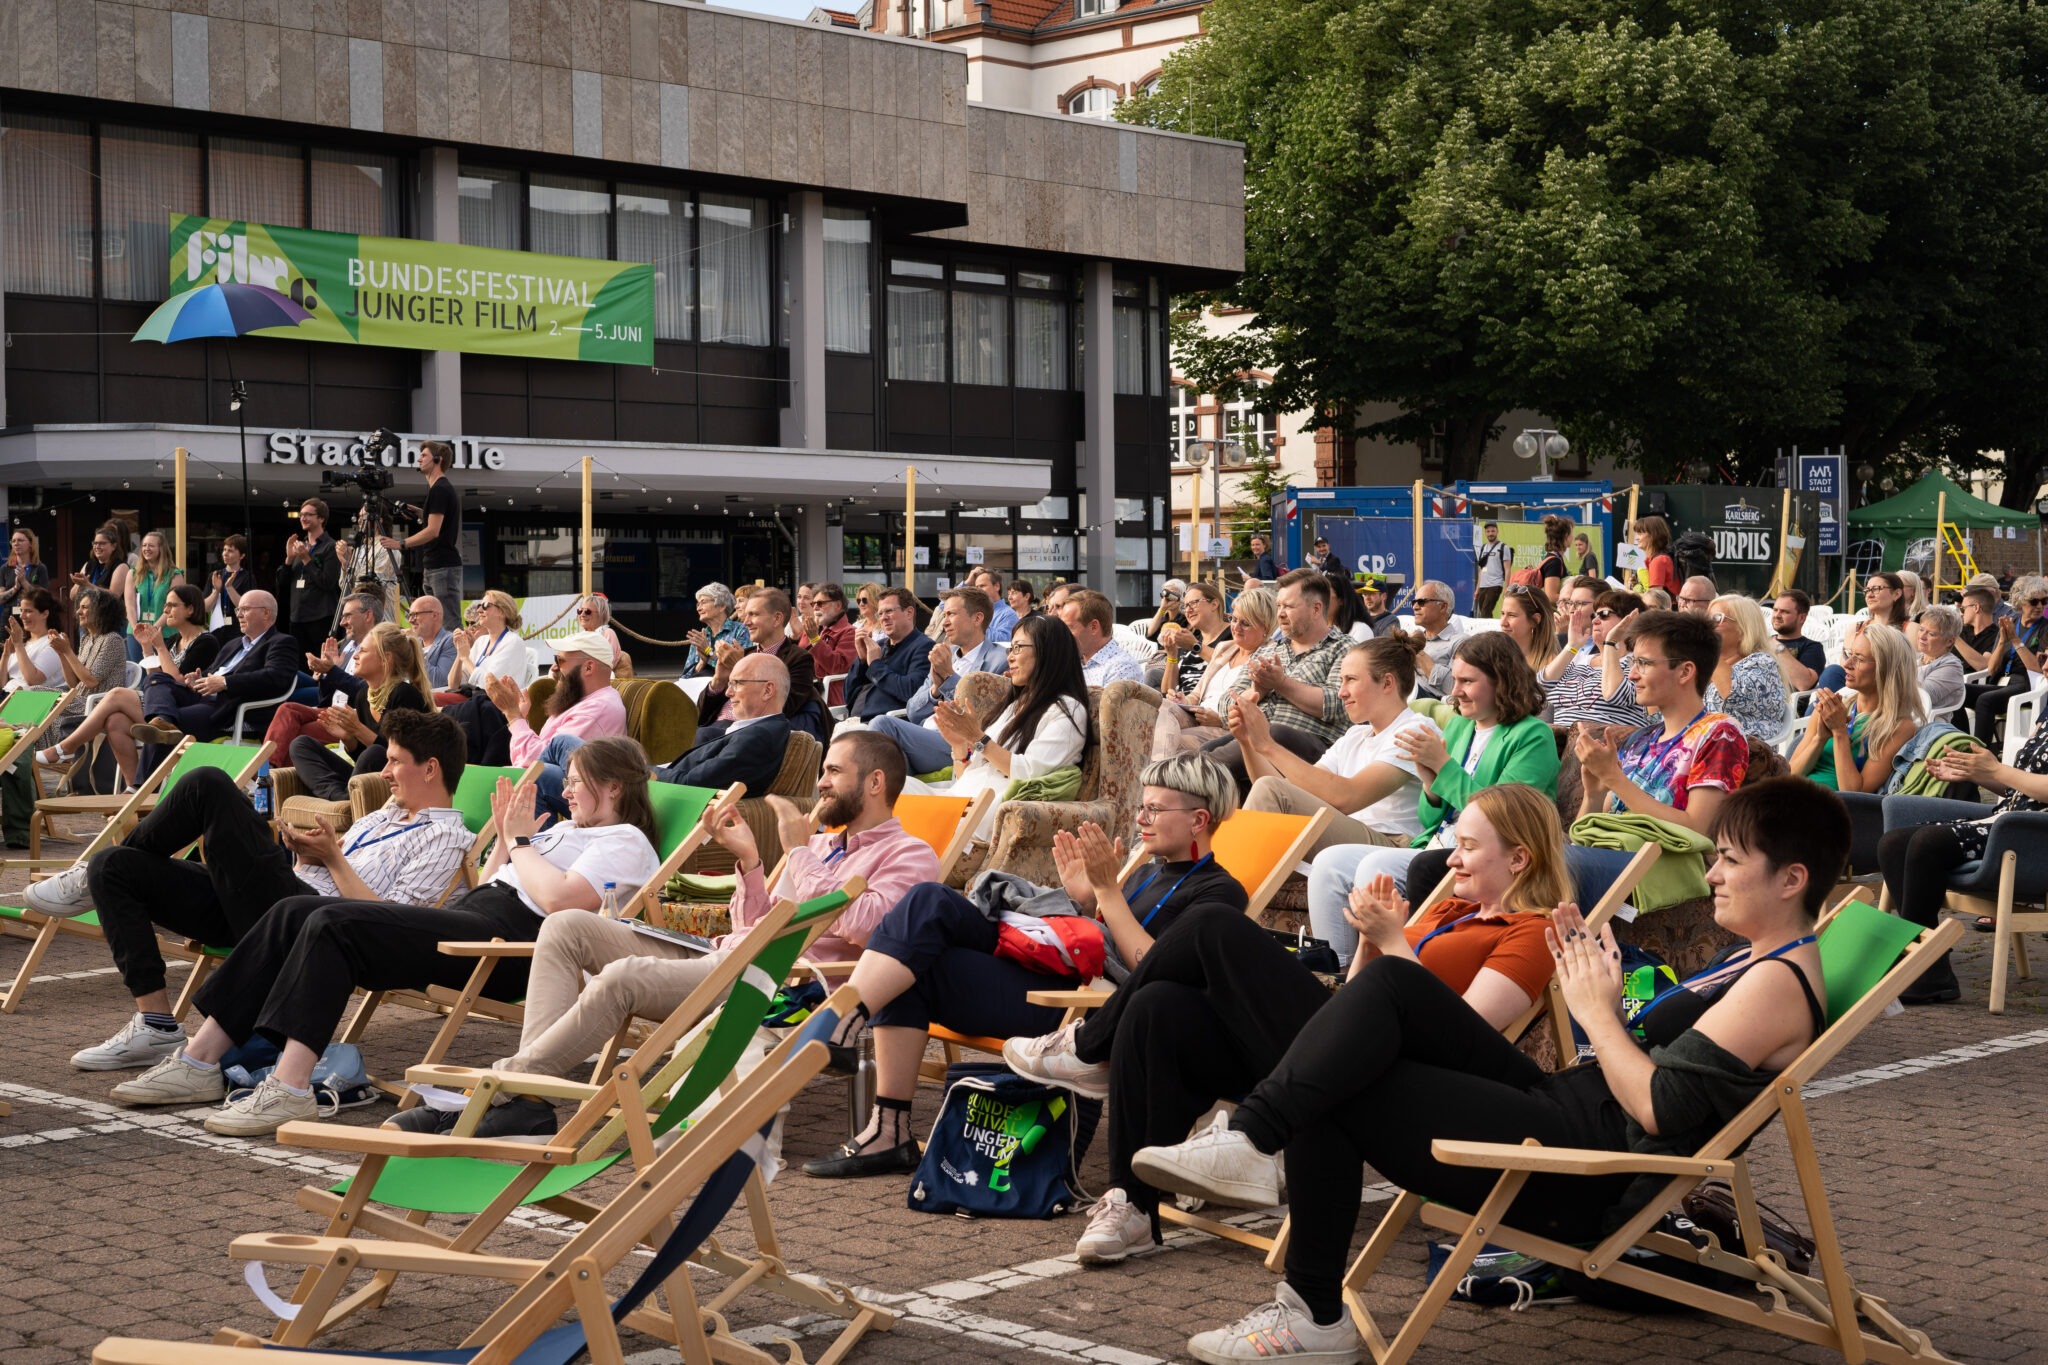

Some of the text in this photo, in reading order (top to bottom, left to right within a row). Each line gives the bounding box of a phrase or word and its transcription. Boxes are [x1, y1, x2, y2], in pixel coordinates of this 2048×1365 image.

[348, 257, 597, 308] BUNDESFESTIVAL
[345, 289, 464, 327] JUNGER
[475, 300, 537, 332] FILM
[609, 325, 642, 342] JUNI
[1809, 478, 1832, 486] STADT
[1725, 510, 1760, 521] KARLSBERG
[1713, 531, 1771, 560] URPILS
[1357, 554, 1386, 575] SR
